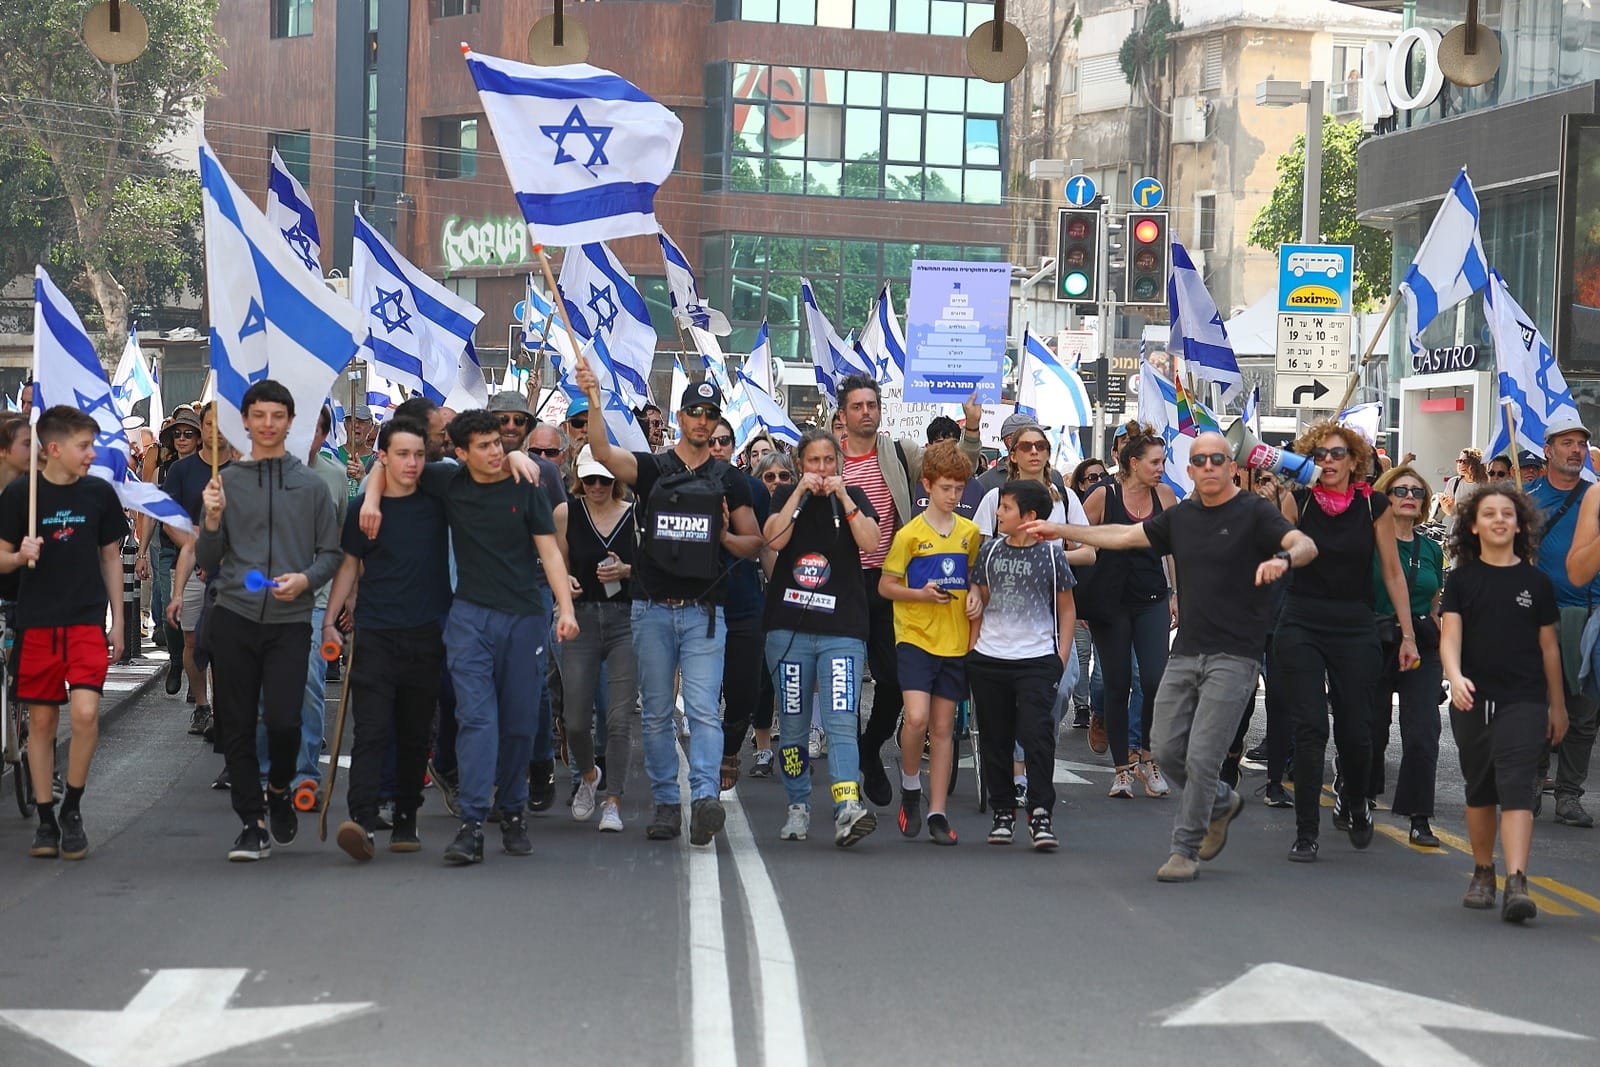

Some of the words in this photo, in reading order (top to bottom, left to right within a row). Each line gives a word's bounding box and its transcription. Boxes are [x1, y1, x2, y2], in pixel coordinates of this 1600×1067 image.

[1289, 330, 1299, 340] 19
[1316, 331, 1326, 341] 10
[1288, 358, 1298, 368] 16
[1412, 344, 1476, 372] CASTRO
[1317, 359, 1324, 369] 9
[937, 380, 974, 389] מתרגלים
[657, 515, 709, 532] נאמנים
[918, 542, 934, 551] FILA
[804, 566, 817, 575] לא
[993, 558, 1032, 576] NEVER
[831, 658, 847, 711] נאמנים
